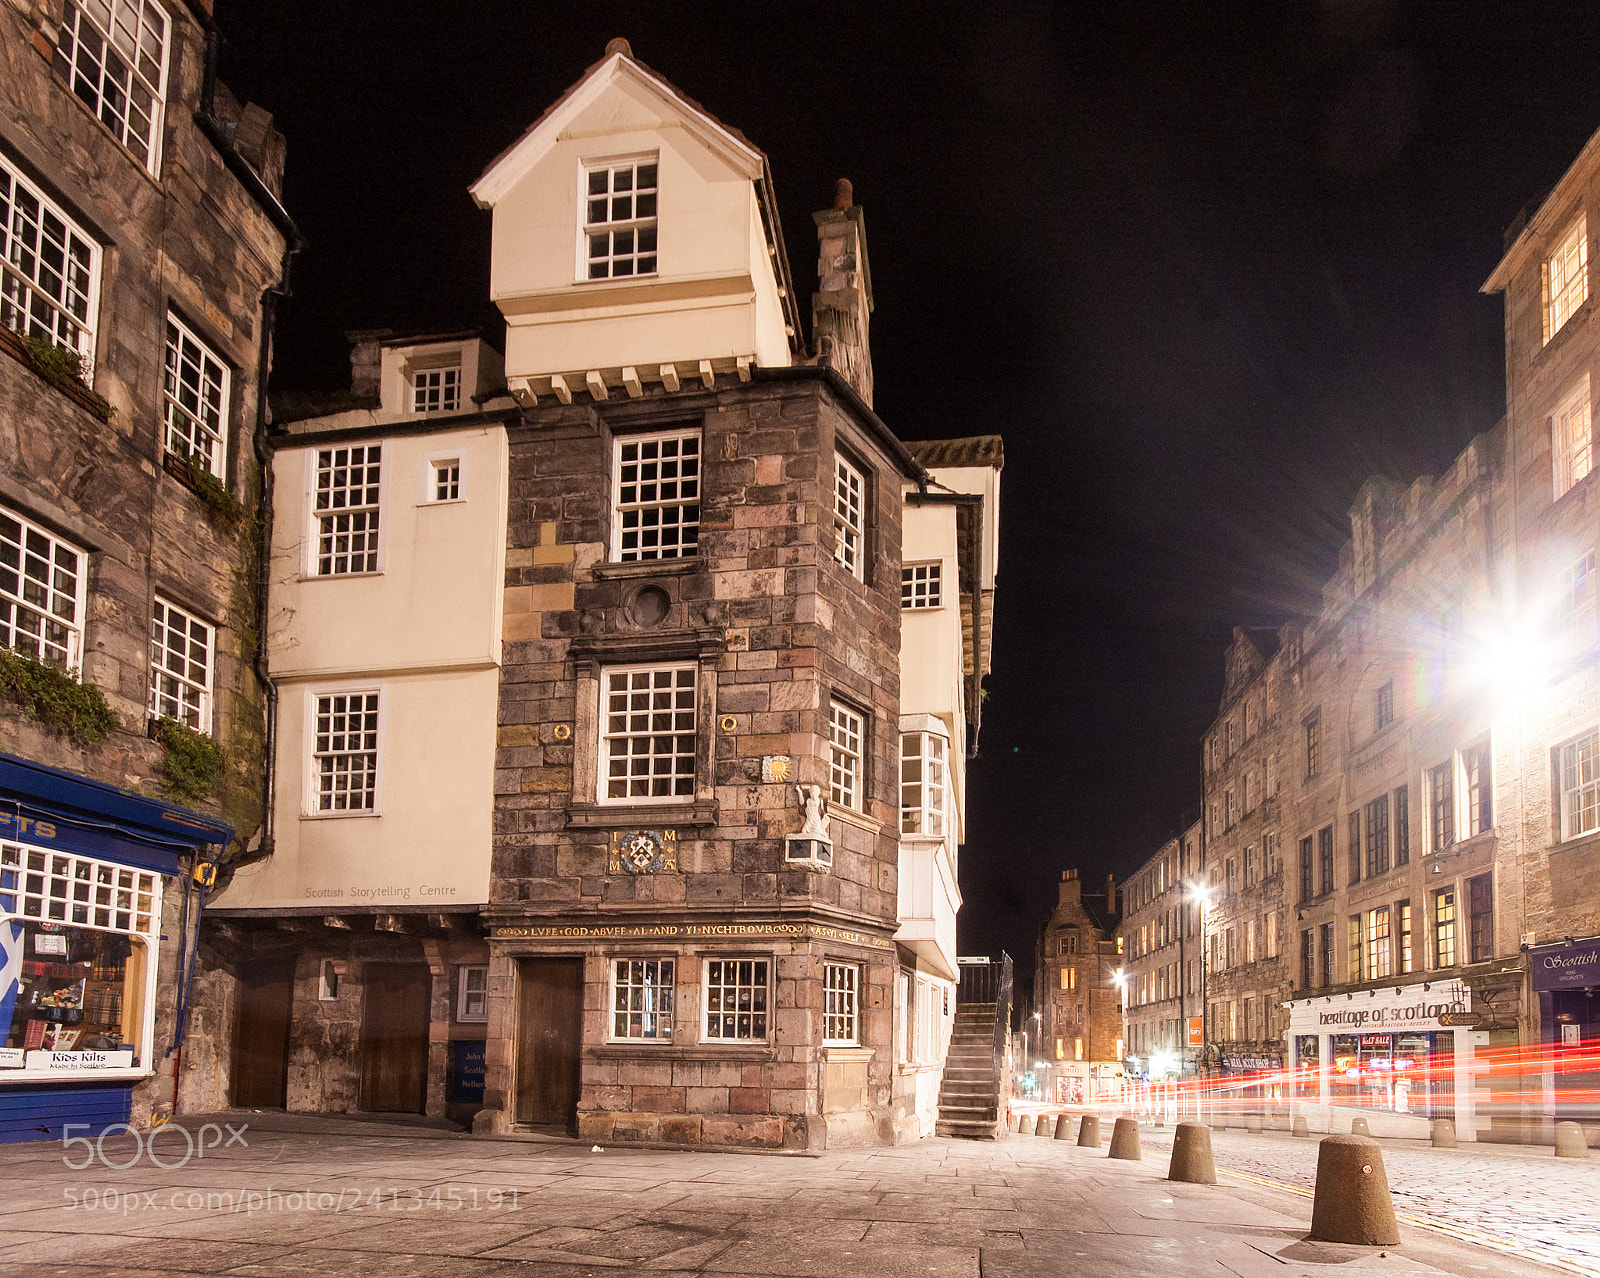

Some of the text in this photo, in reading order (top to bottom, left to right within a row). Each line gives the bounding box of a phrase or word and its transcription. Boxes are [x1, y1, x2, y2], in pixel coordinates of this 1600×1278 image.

[664, 830, 676, 841] M
[609, 860, 620, 871] M
[305, 885, 456, 900] Scottish Storytelling Centre
[564, 927, 588, 936] GOD
[634, 926, 648, 935] AL
[653, 926, 678, 935] AND
[842, 932, 860, 942] SELF
[1543, 950, 1598, 969] Scottish
[1319, 1010, 1369, 1028] heritage
[1371, 1007, 1388, 1026] of
[1375, 1036, 1390, 1044] SALE
[52, 1052, 106, 1062] Kids Kilts
[465, 1052, 481, 1060] John
[464, 1066, 485, 1074] Scotla
[462, 1080, 484, 1088] Nether
